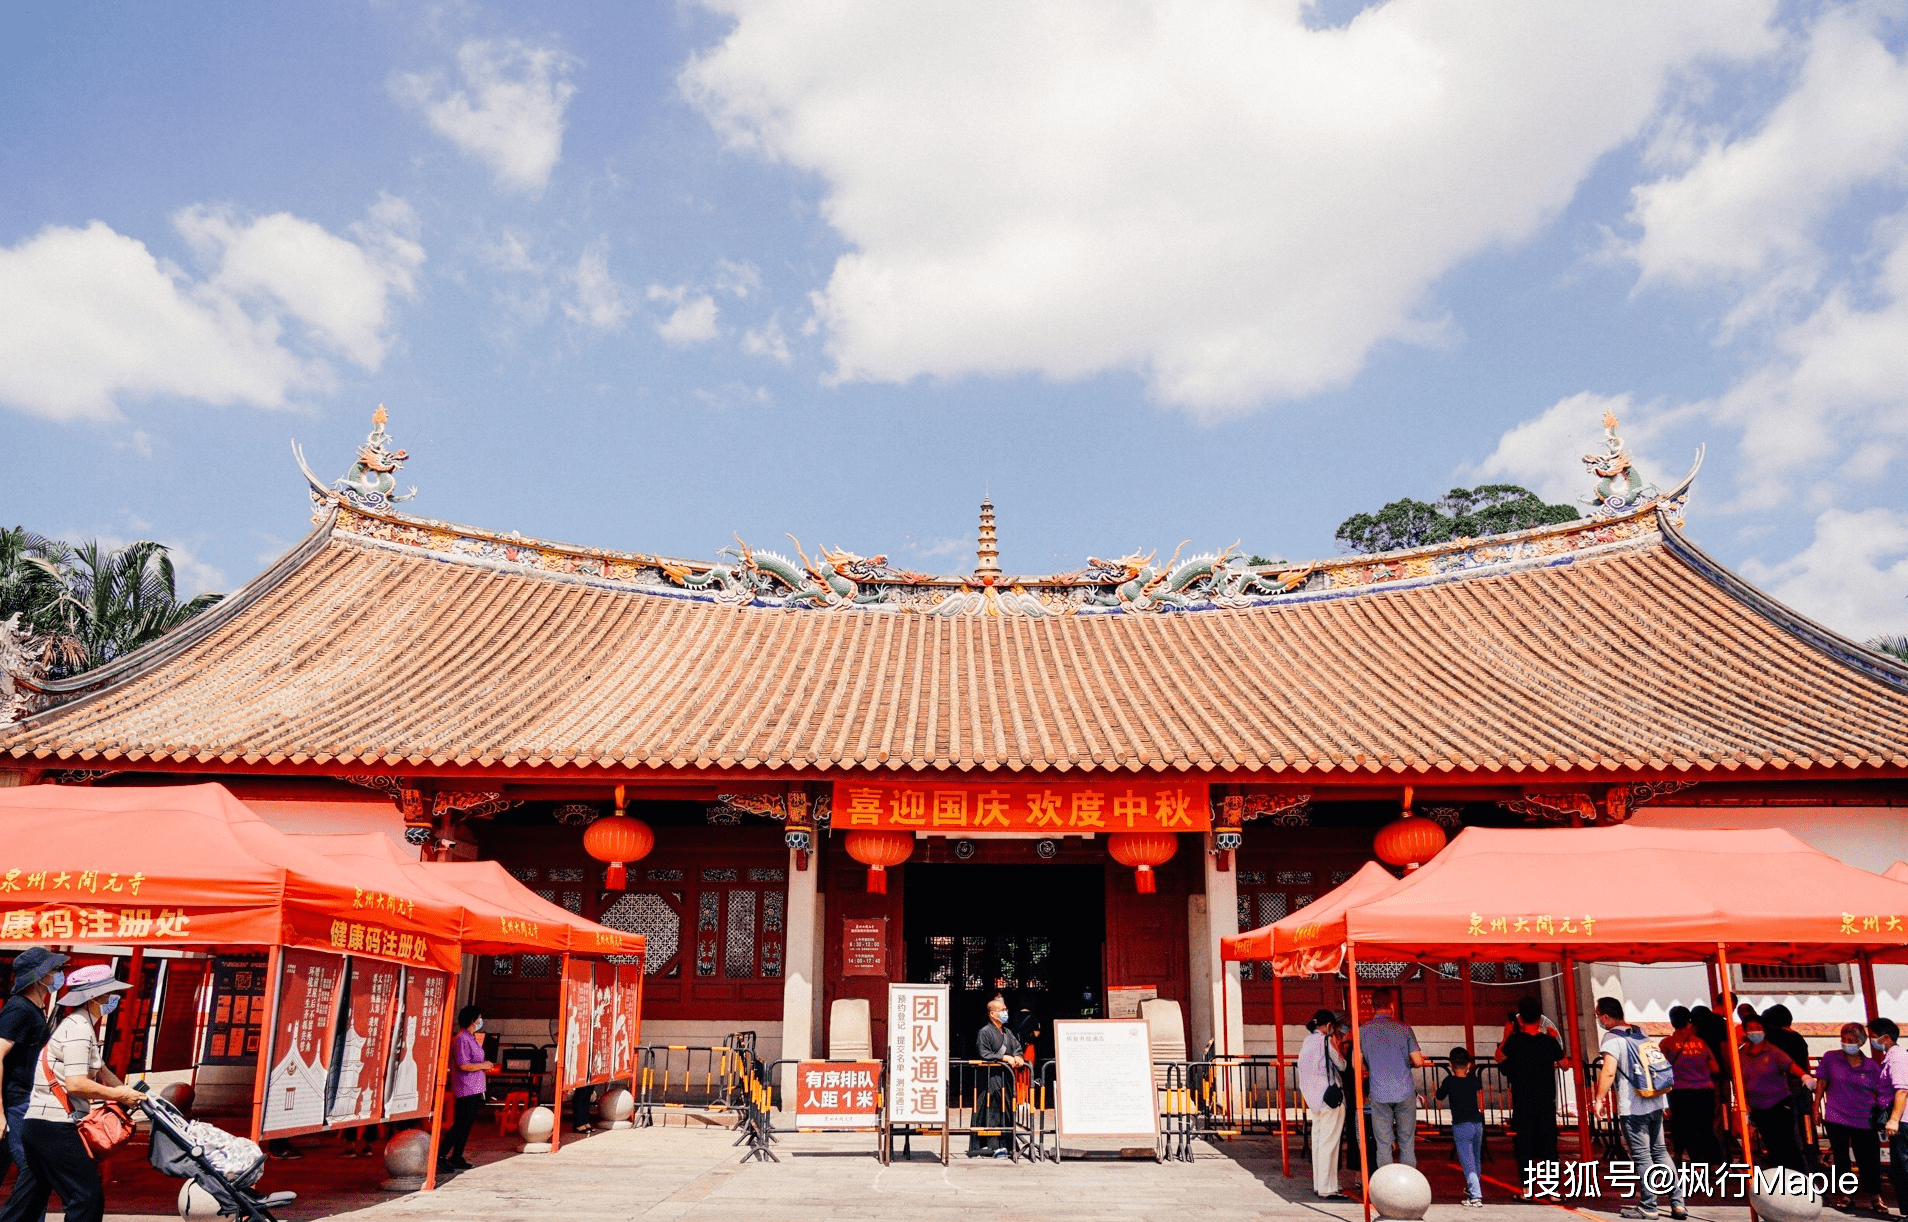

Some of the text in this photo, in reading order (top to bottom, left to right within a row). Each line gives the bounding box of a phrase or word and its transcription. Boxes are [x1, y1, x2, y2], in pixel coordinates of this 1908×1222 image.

[847, 787, 1194, 828] 喜迎国庆 欢度中秋
[0, 908, 190, 940] 康码注册处
[330, 919, 428, 962] 健康码注册处
[1839, 911, 1904, 935] 泉州大
[895, 994, 907, 1116] 预约登记 提交名单 测温通行
[910, 995, 939, 1115] 团队通道
[805, 1070, 875, 1088] 有序排队
[803, 1090, 874, 1108] 人距1米
